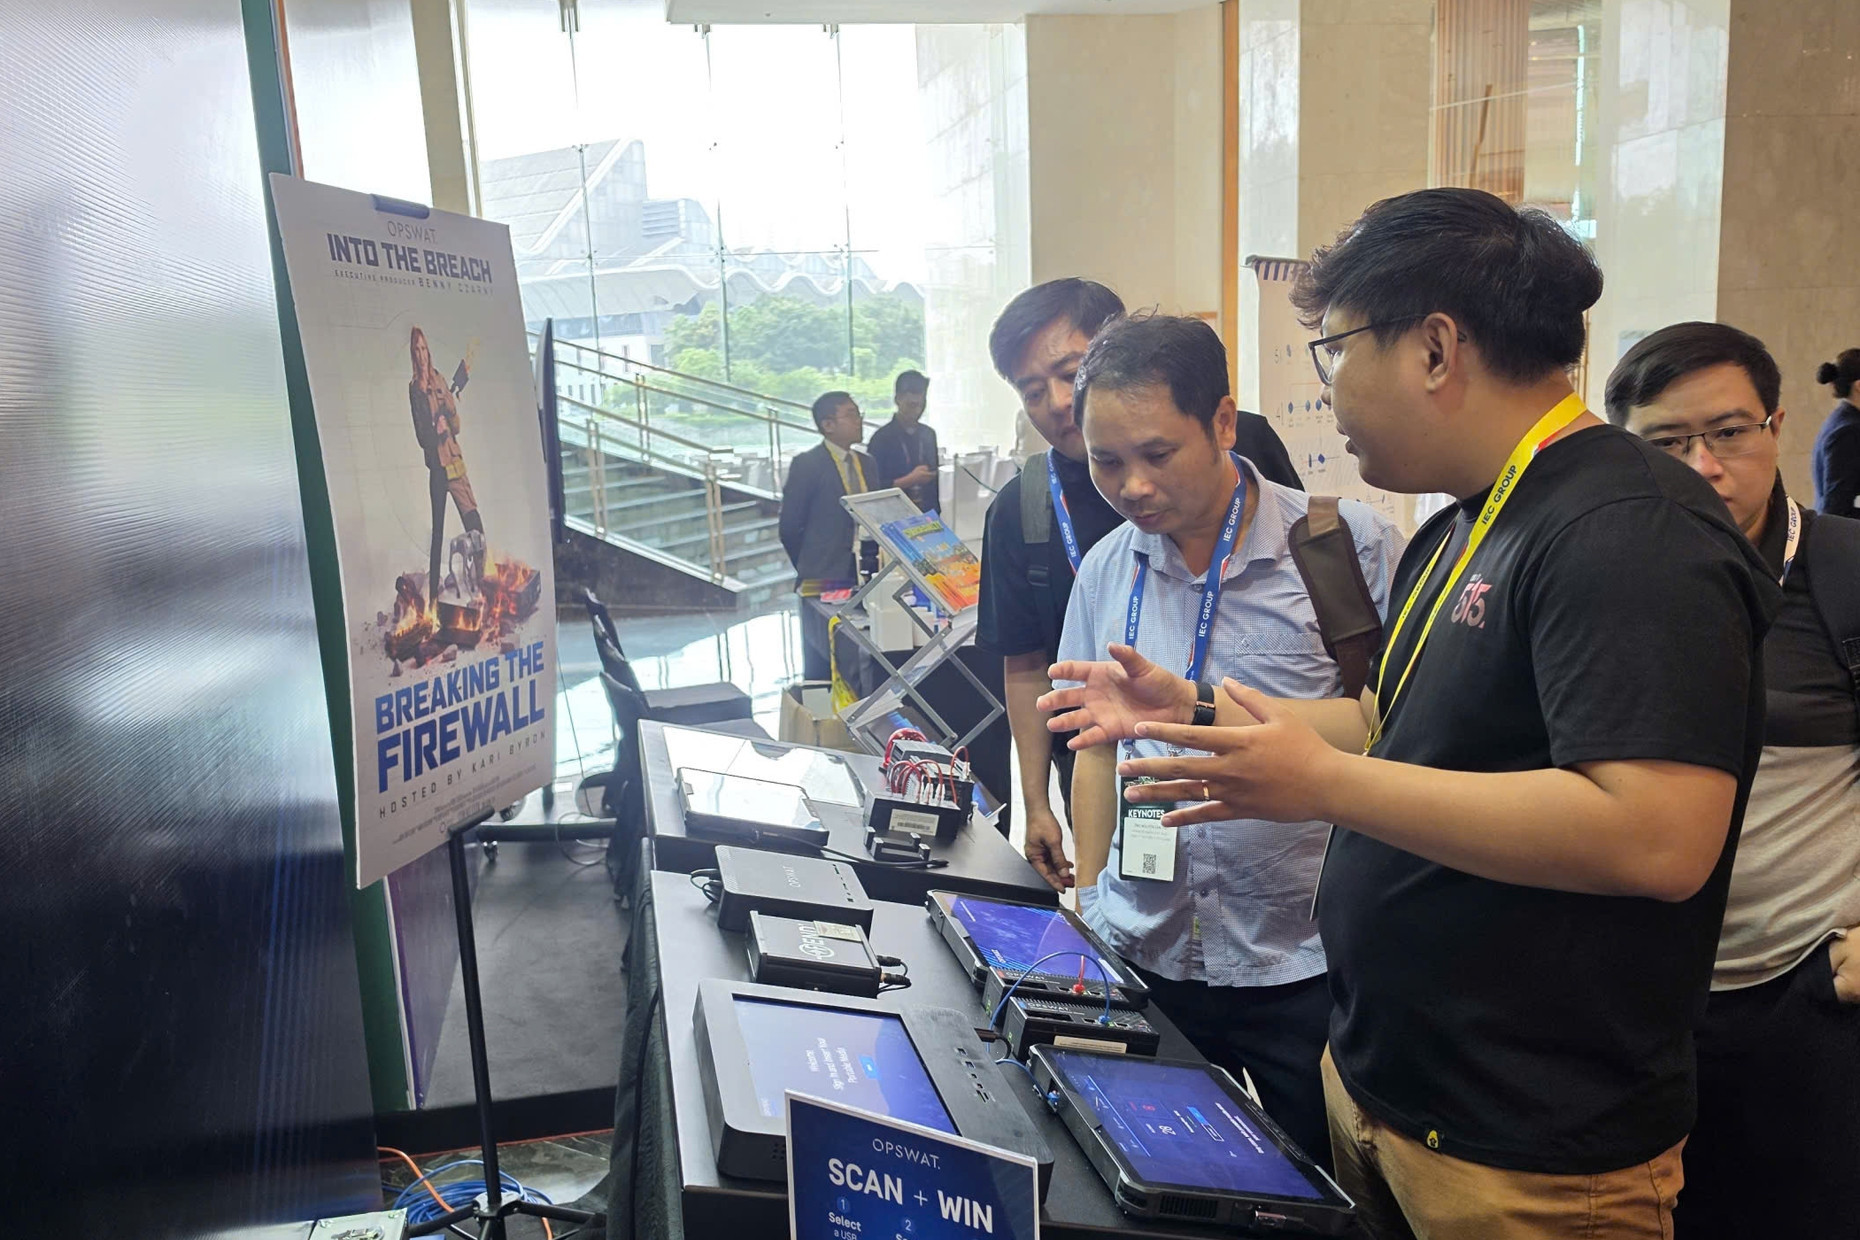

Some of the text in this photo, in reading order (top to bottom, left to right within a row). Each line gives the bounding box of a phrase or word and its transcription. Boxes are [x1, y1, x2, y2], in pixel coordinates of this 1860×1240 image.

[327, 233, 493, 284] INTO THE BREACH
[1480, 464, 1518, 526] IEC GROUP
[1062, 521, 1077, 558] IEC GROUP
[1222, 497, 1240, 542] IEC GROUP
[1128, 595, 1140, 640] IEC GROUP
[1198, 590, 1215, 638] IEC GROUP
[375, 641, 545, 735] BREAKING THE
[377, 679, 546, 794] FIREWALL
[379, 782, 437, 819] HOSTED
[447, 768, 462, 786] BY
[472, 752, 501, 774] KARI
[509, 731, 546, 756] BYRON
[828, 1157, 994, 1234] SCAN + WIN
[828, 1211, 862, 1232] Select
[833, 1229, 857, 1240] a USB
[905, 1219, 912, 1232] 2
